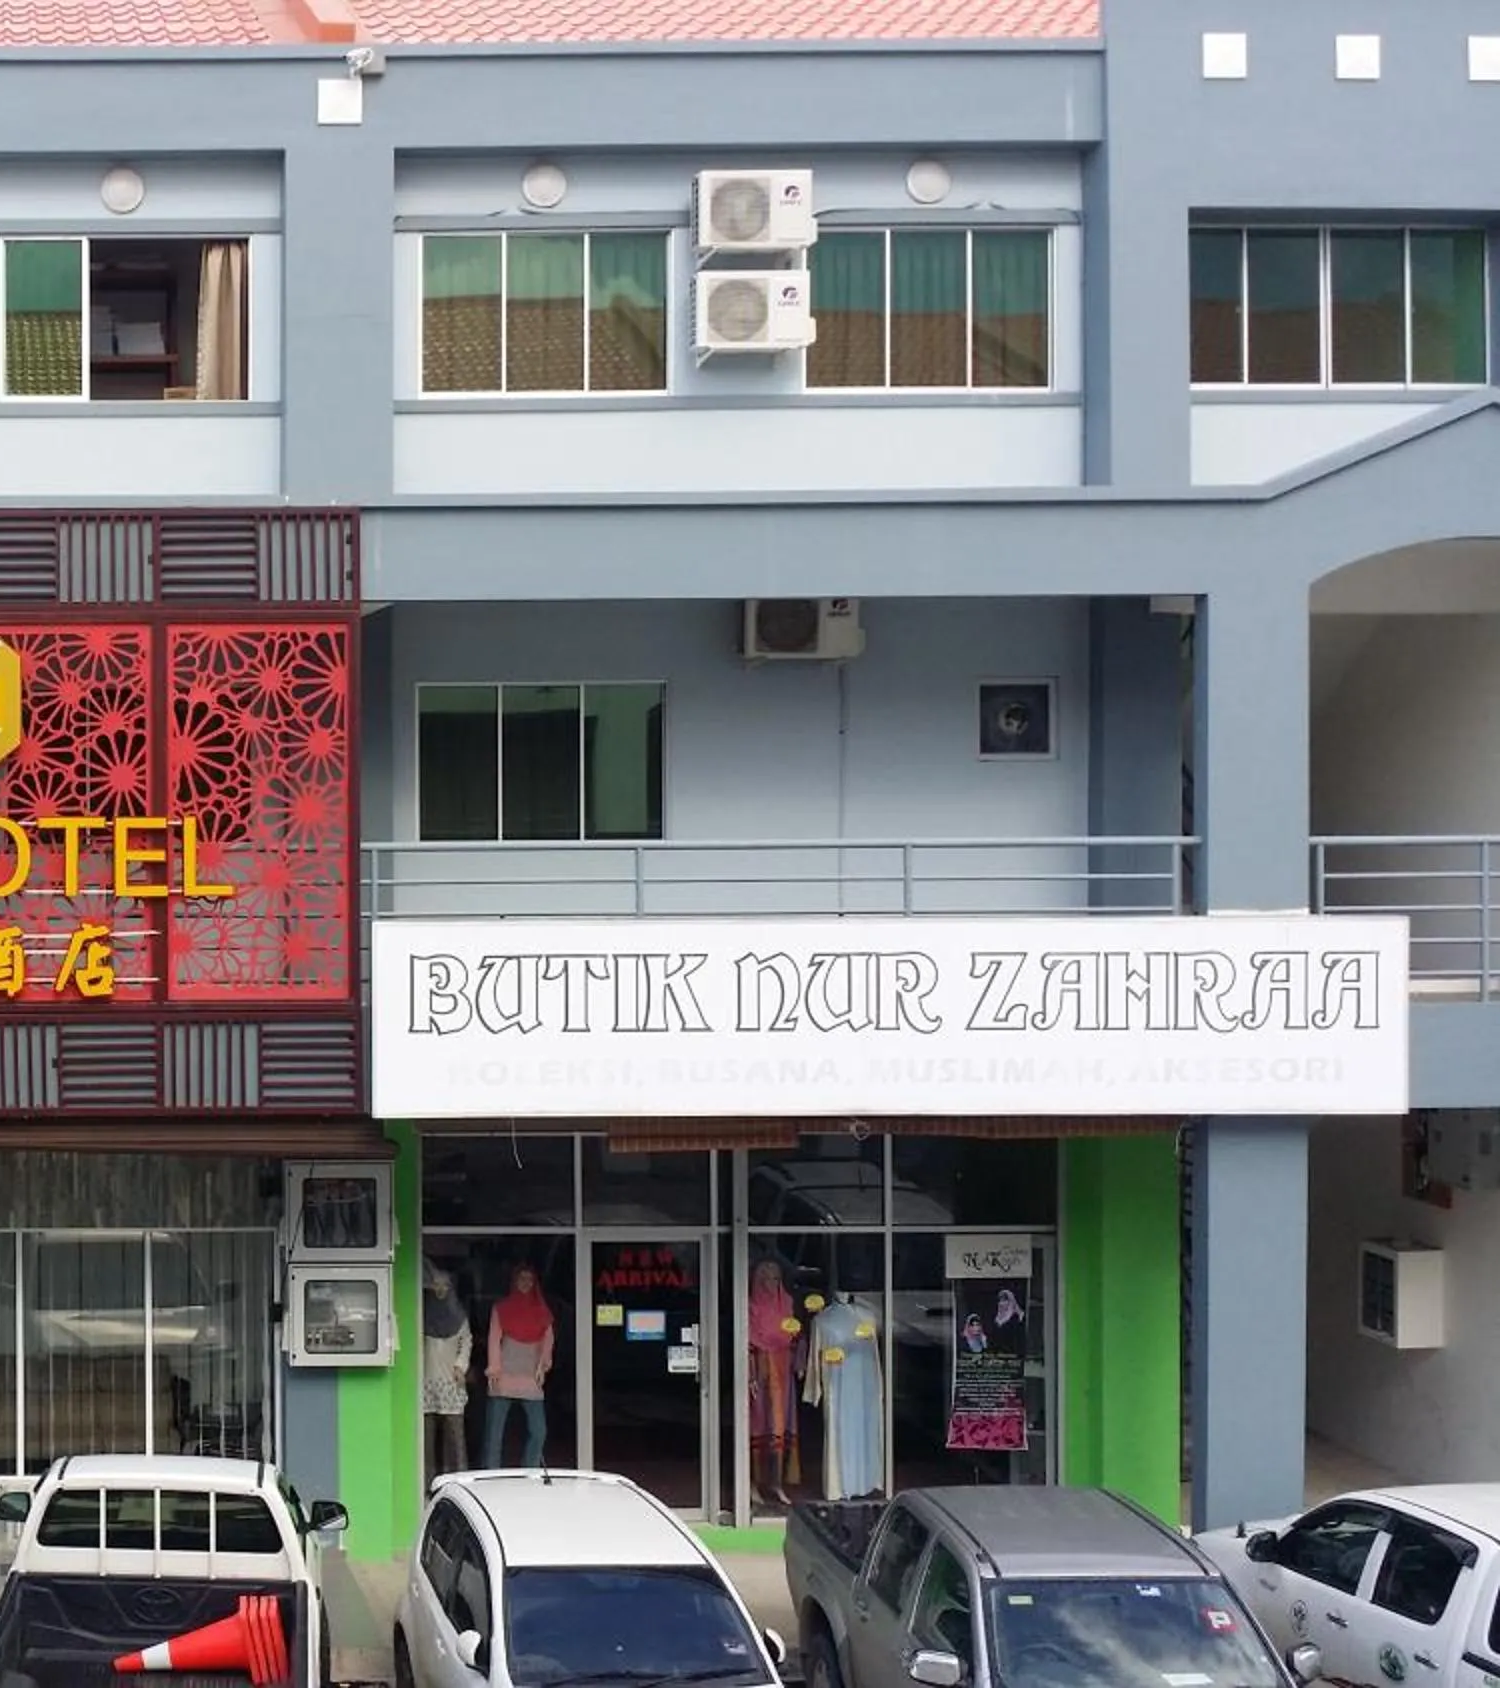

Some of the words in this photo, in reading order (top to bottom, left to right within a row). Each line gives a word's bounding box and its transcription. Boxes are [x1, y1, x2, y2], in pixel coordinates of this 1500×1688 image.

[407, 952, 714, 1036] BUTIK
[734, 951, 943, 1034] NUR
[965, 951, 1381, 1033] ZAHRAA
[866, 1056, 1117, 1087] MUSLIMAH,
[1129, 1056, 1346, 1083] AKSESORI
[597, 1268, 694, 1288] ARRIVAL
